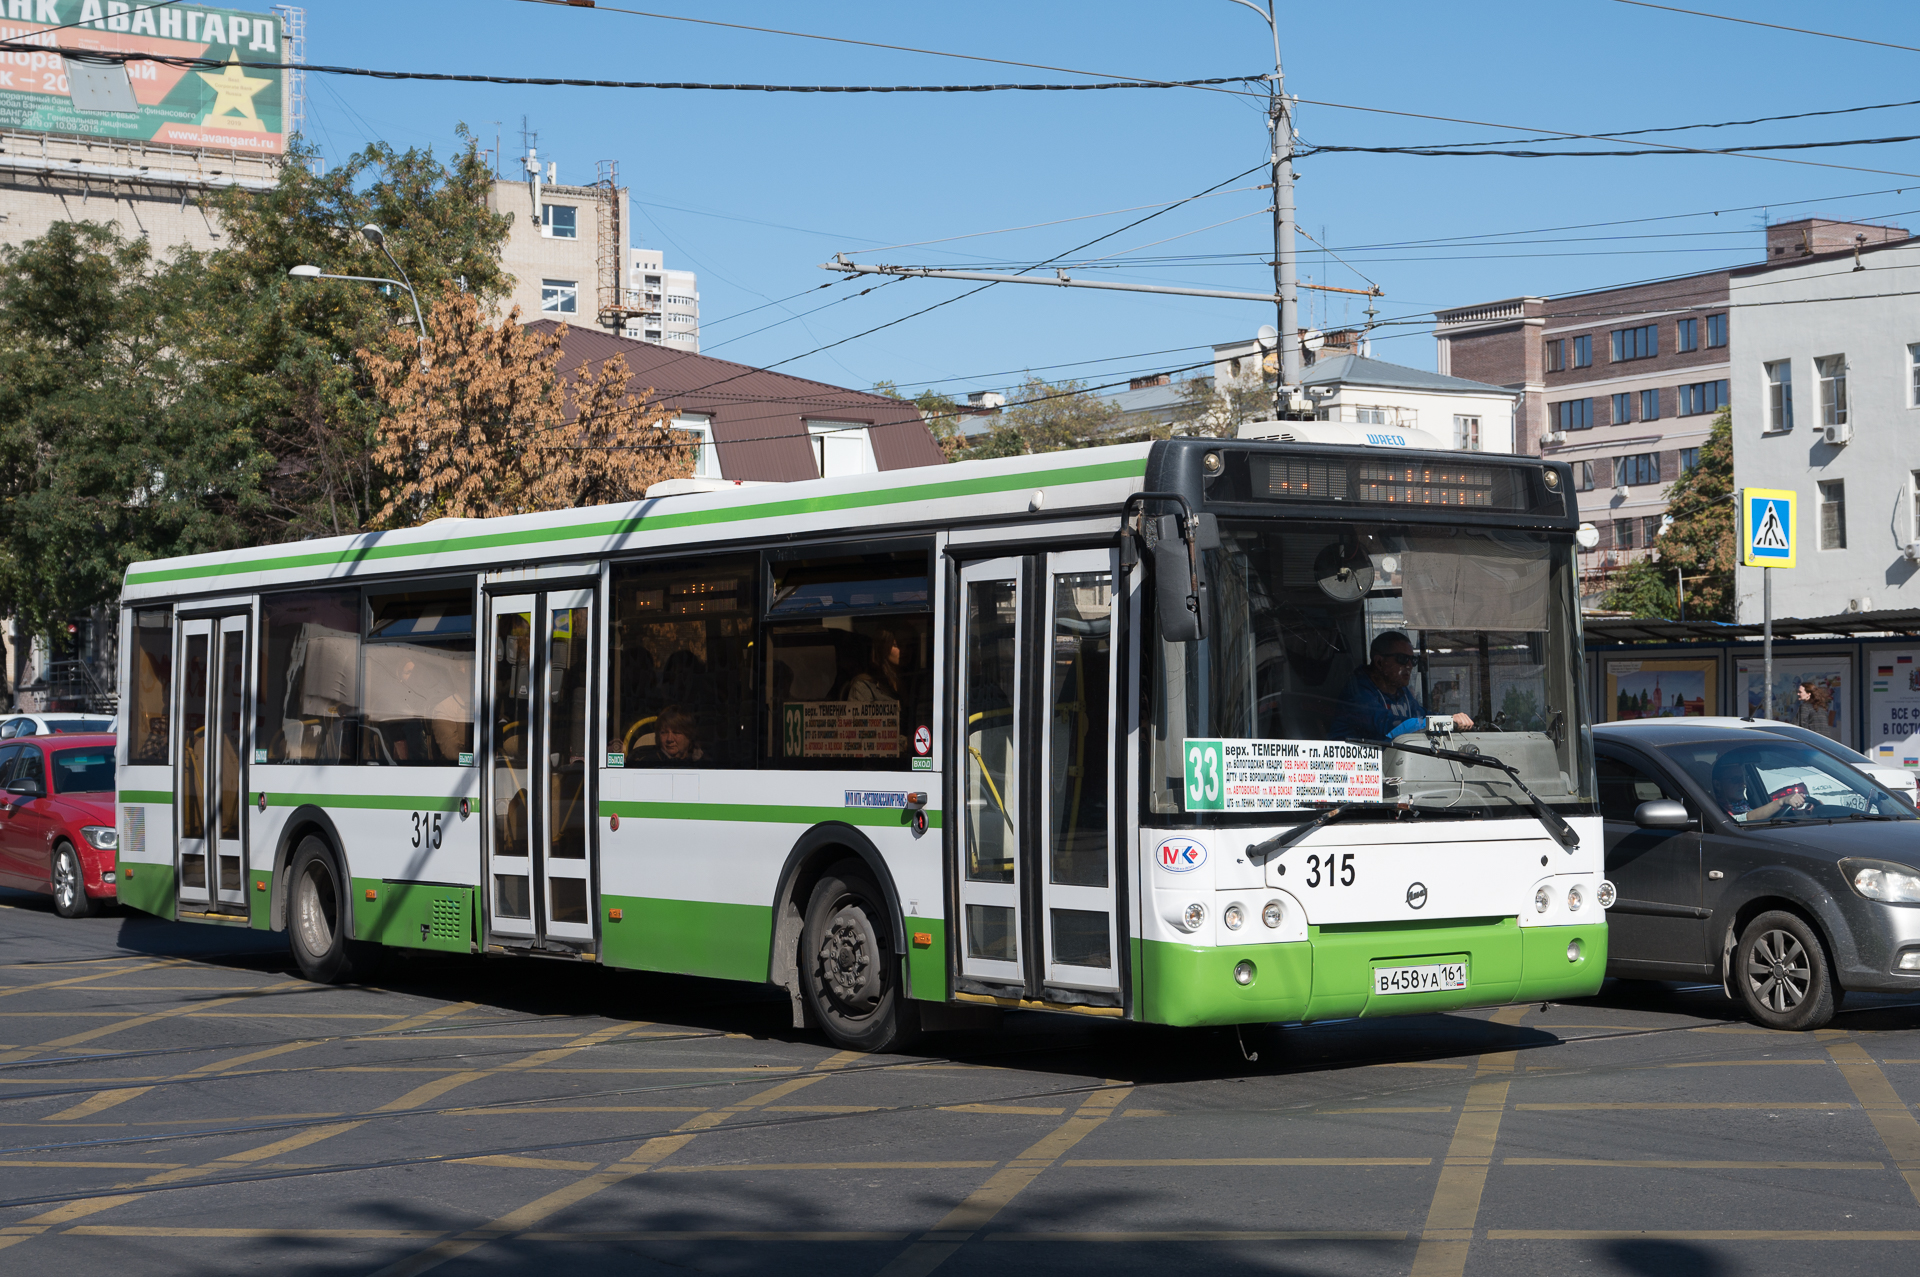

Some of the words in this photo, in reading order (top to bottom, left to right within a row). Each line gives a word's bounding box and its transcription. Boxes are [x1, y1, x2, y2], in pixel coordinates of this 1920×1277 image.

[0, 0, 61, 24] НК
[78, 0, 276, 53] АВАНГАРД
[51, 96, 71, 105] банк
[144, 107, 196, 119] финансового
[22, 118, 42, 127] 2879
[55, 121, 99, 133] 10.09.2015
[47, 113, 99, 125] Генеральная
[100, 119, 138, 130] лицензия
[168, 130, 274, 148] www.avangard.ru
[1366, 434, 1406, 446] WAECO
[819, 704, 847, 716] ТЕМЕРНИК
[861, 704, 897, 716] АВТОВОКЗАЛ
[1891, 707, 1909, 720] ВСЕ
[786, 709, 802, 757] 33
[1883, 723, 1889, 735] В
[1225, 746, 1249, 759] верх.
[1251, 743, 1300, 757] ТЕМЕРНИК
[1309, 748, 1320, 758] гл.
[1323, 745, 1379, 759] АВТОВОКЗАЛ
[913, 760, 931, 768] ВХОД
[1294, 760, 1309, 770] РЫНОК
[1335, 761, 1356, 771] ГОРИЗОНТ
[1364, 762, 1379, 771] ЛЕНИНА
[1189, 747, 1220, 802] 33
[1249, 771, 1286, 782] ВОРОШИЛОВСКИЙ
[1365, 774, 1380, 784] ВОКЗАЛ
[1233, 785, 1260, 795] АВТОВОКЗАЛ
[1278, 786, 1293, 795] ВОКЗАЛ
[411, 811, 442, 850] 315
[1306, 853, 1355, 888] 315
[1380, 970, 1439, 991] В458УА
[1441, 966, 1462, 981] 161
